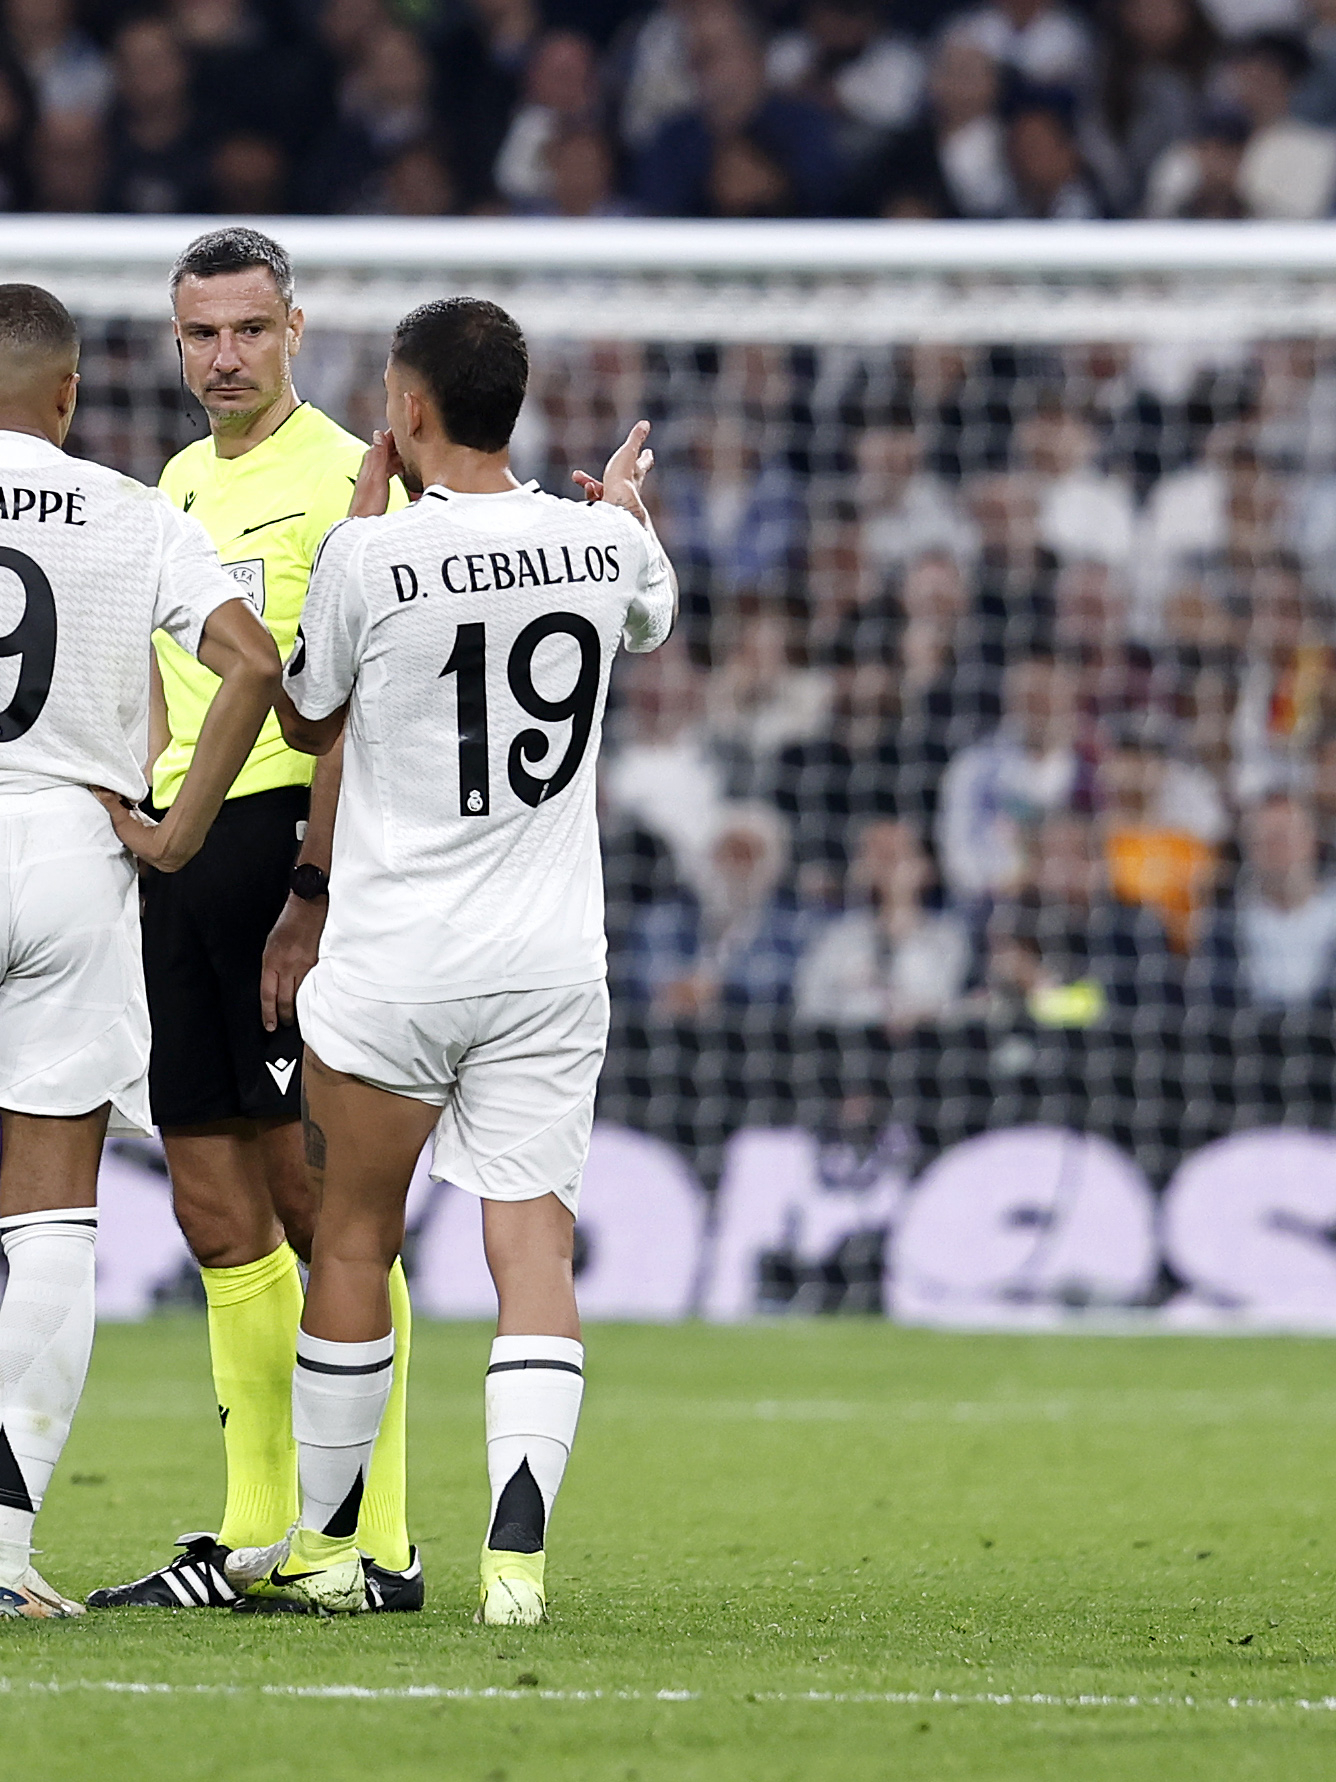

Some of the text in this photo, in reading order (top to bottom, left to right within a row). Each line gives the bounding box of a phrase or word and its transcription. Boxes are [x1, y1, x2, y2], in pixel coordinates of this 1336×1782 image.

[233, 570, 254, 581] EFA
[390, 545, 620, 602] D. CEBALLOS
[439, 612, 601, 817] 19
